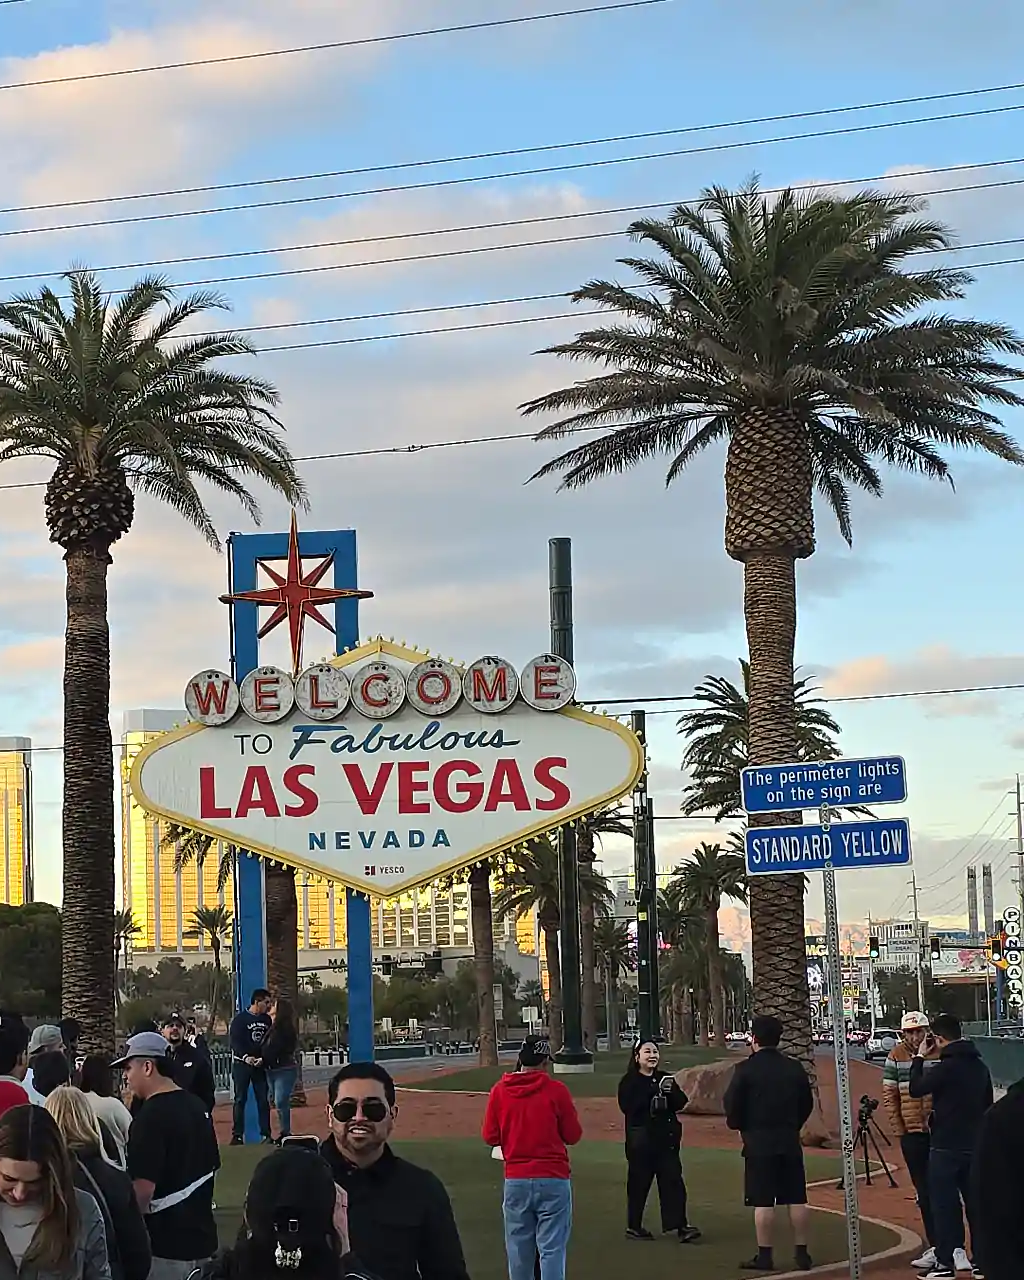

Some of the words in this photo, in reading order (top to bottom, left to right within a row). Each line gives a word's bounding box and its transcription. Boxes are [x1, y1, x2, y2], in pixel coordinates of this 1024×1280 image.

[191, 665, 560, 716] WELCOME
[234, 733, 273, 756] TO
[289, 721, 520, 760] Fabulous
[199, 763, 317, 819] LAS
[345, 757, 571, 817] VEGAS
[747, 771, 773, 786] The
[780, 767, 852, 789] perimeter
[859, 762, 900, 781] lights
[767, 790, 784, 803] on
[791, 787, 815, 800] the
[821, 785, 851, 802] sign
[859, 782, 882, 796] are
[309, 829, 451, 851] NEVADA
[752, 834, 832, 864] STANDARD
[841, 829, 903, 858] YELLOW
[379, 866, 405, 875] YESCO
